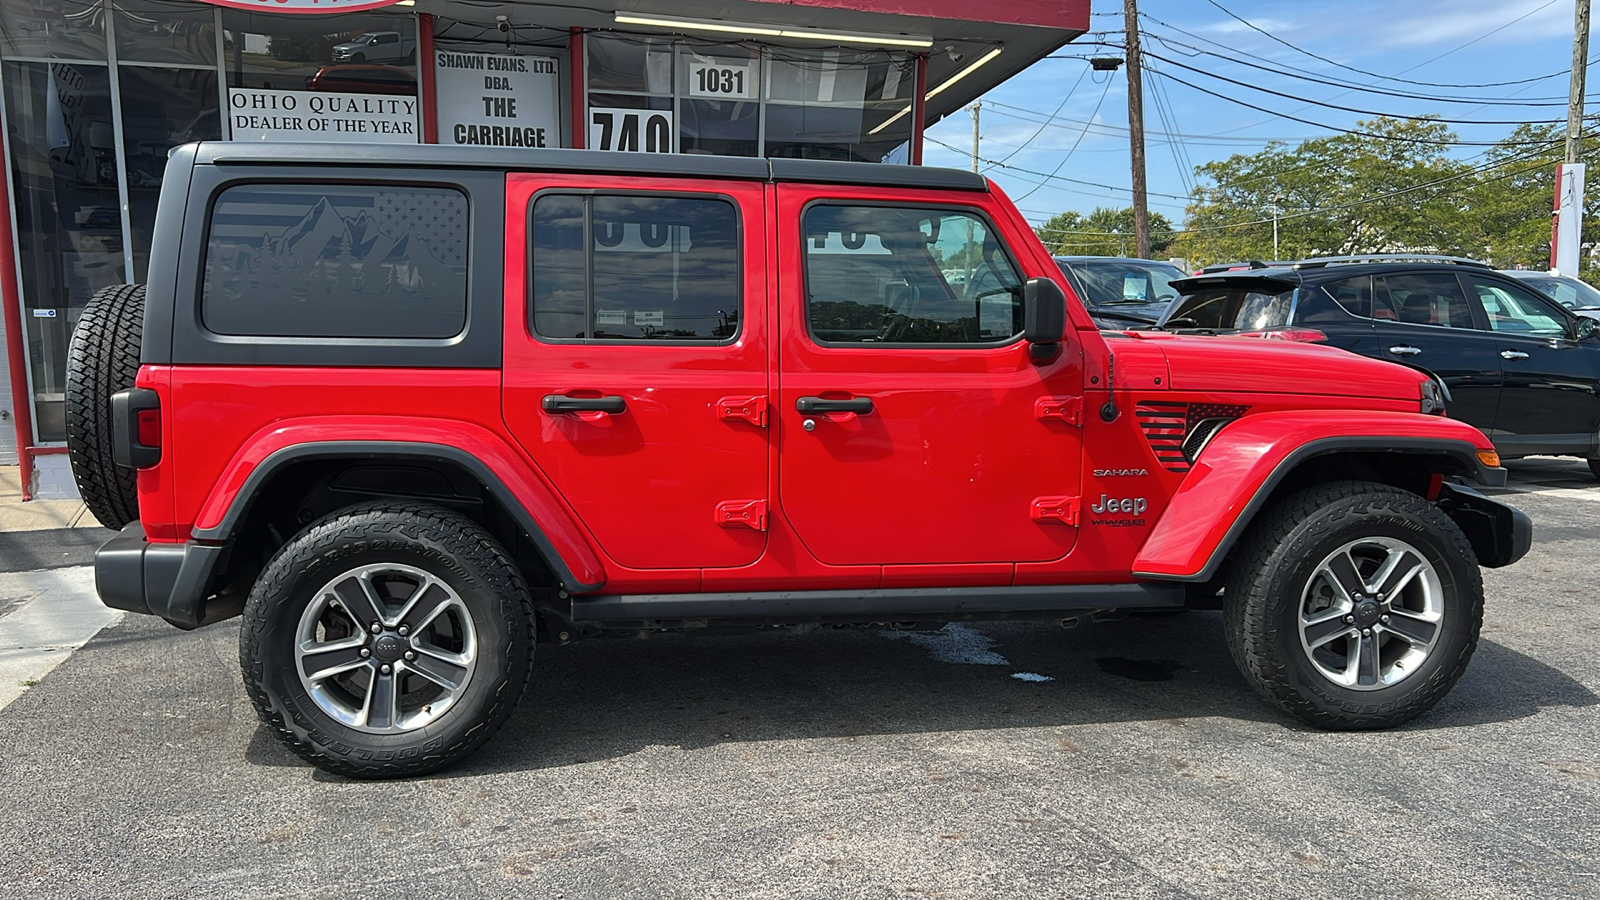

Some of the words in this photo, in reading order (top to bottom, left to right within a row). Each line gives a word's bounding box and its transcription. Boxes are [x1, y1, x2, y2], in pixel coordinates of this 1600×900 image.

[438, 54, 484, 70] SHAWN
[487, 57, 528, 73] EVANS.
[533, 60, 557, 75] LTD.
[484, 76, 513, 91] DBA.
[696, 68, 743, 94] 1031
[232, 93, 297, 111] OHIO
[309, 96, 415, 115] QUALITY
[482, 97, 517, 118] THE
[235, 115, 303, 131] DEALER
[307, 118, 329, 132] OF
[333, 119, 367, 133] THE
[370, 120, 414, 134] YEAR
[593, 112, 670, 153] 740
[454, 124, 546, 148] CARRIAGE
[1093, 468, 1149, 476] SAHARA
[1091, 494, 1147, 516] Jeep
